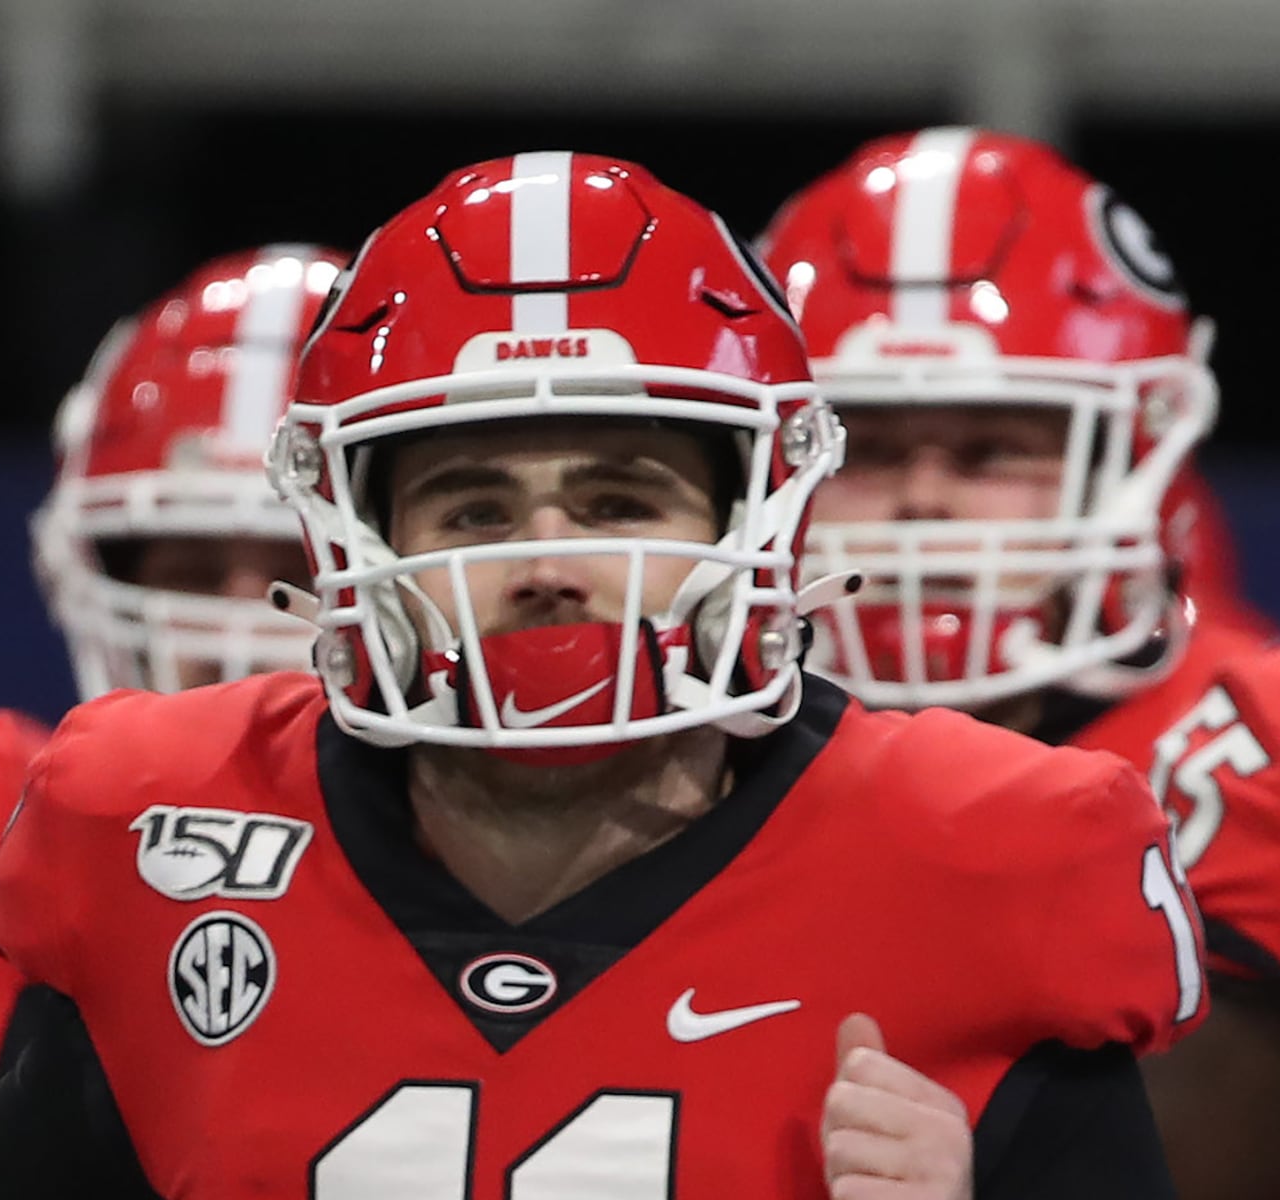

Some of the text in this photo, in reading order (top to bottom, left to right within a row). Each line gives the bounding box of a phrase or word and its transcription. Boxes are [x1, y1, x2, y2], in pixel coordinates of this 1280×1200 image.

[495, 337, 589, 361] DAWGS
[133, 806, 312, 899] 150
[173, 917, 272, 1040] SEC
[470, 957, 557, 1007] G
